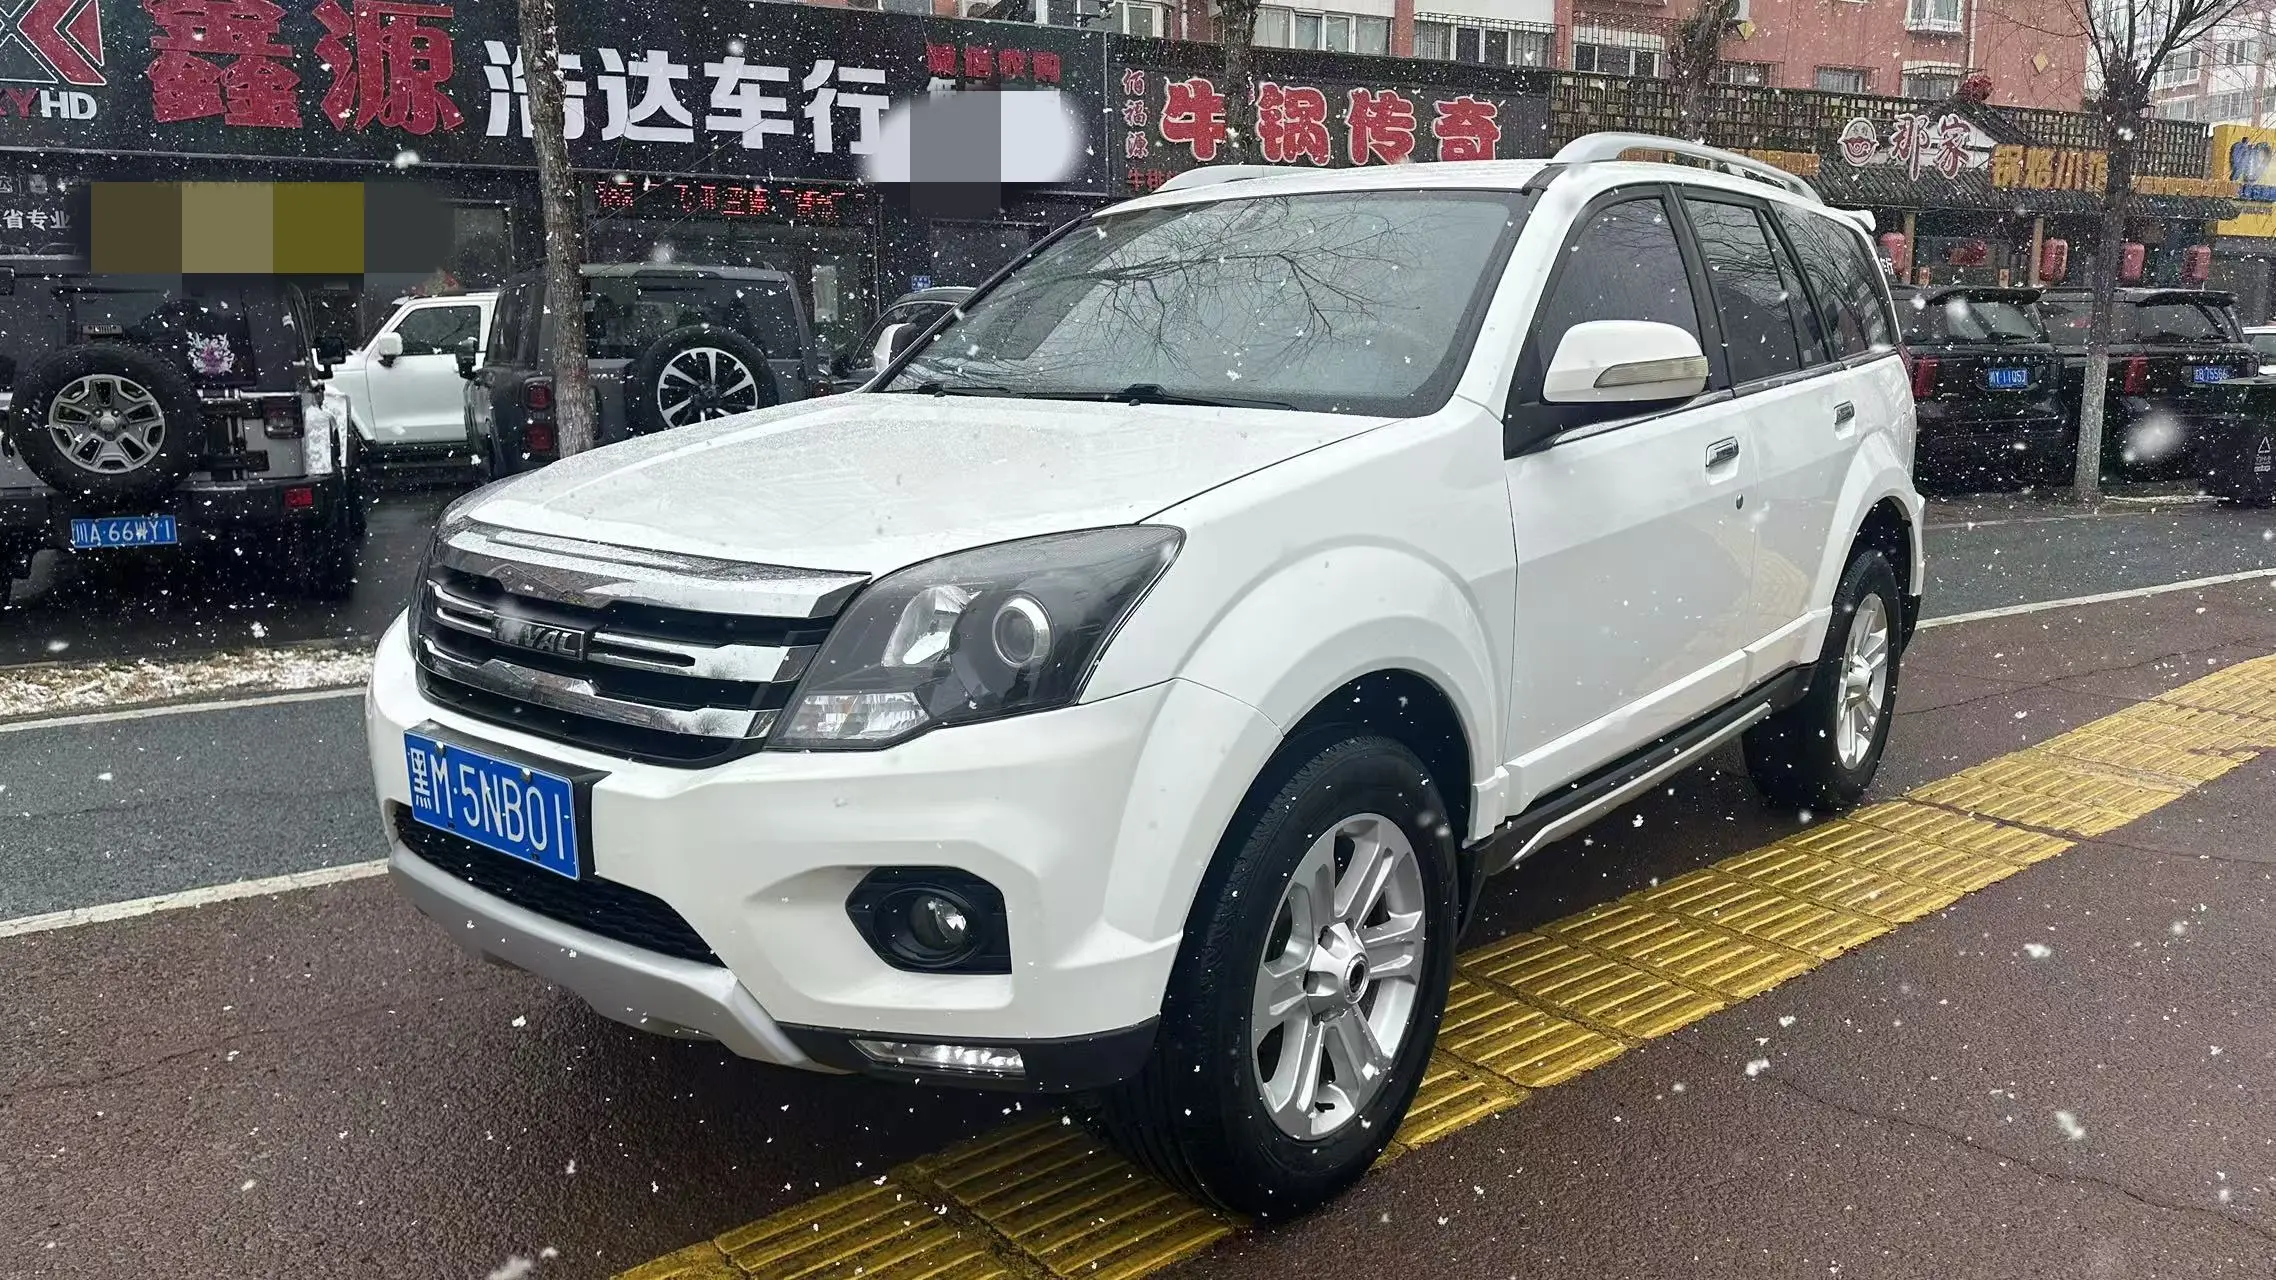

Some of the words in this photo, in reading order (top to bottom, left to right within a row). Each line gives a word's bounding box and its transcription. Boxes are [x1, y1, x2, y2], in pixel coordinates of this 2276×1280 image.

[0, 88, 97, 120] YHD
[143, 0, 464, 135] 鑫源
[483, 40, 890, 155] 浩达车行
[1160, 76, 1501, 166] 牛锅传奇
[2, 208, 73, 232] 省专业
